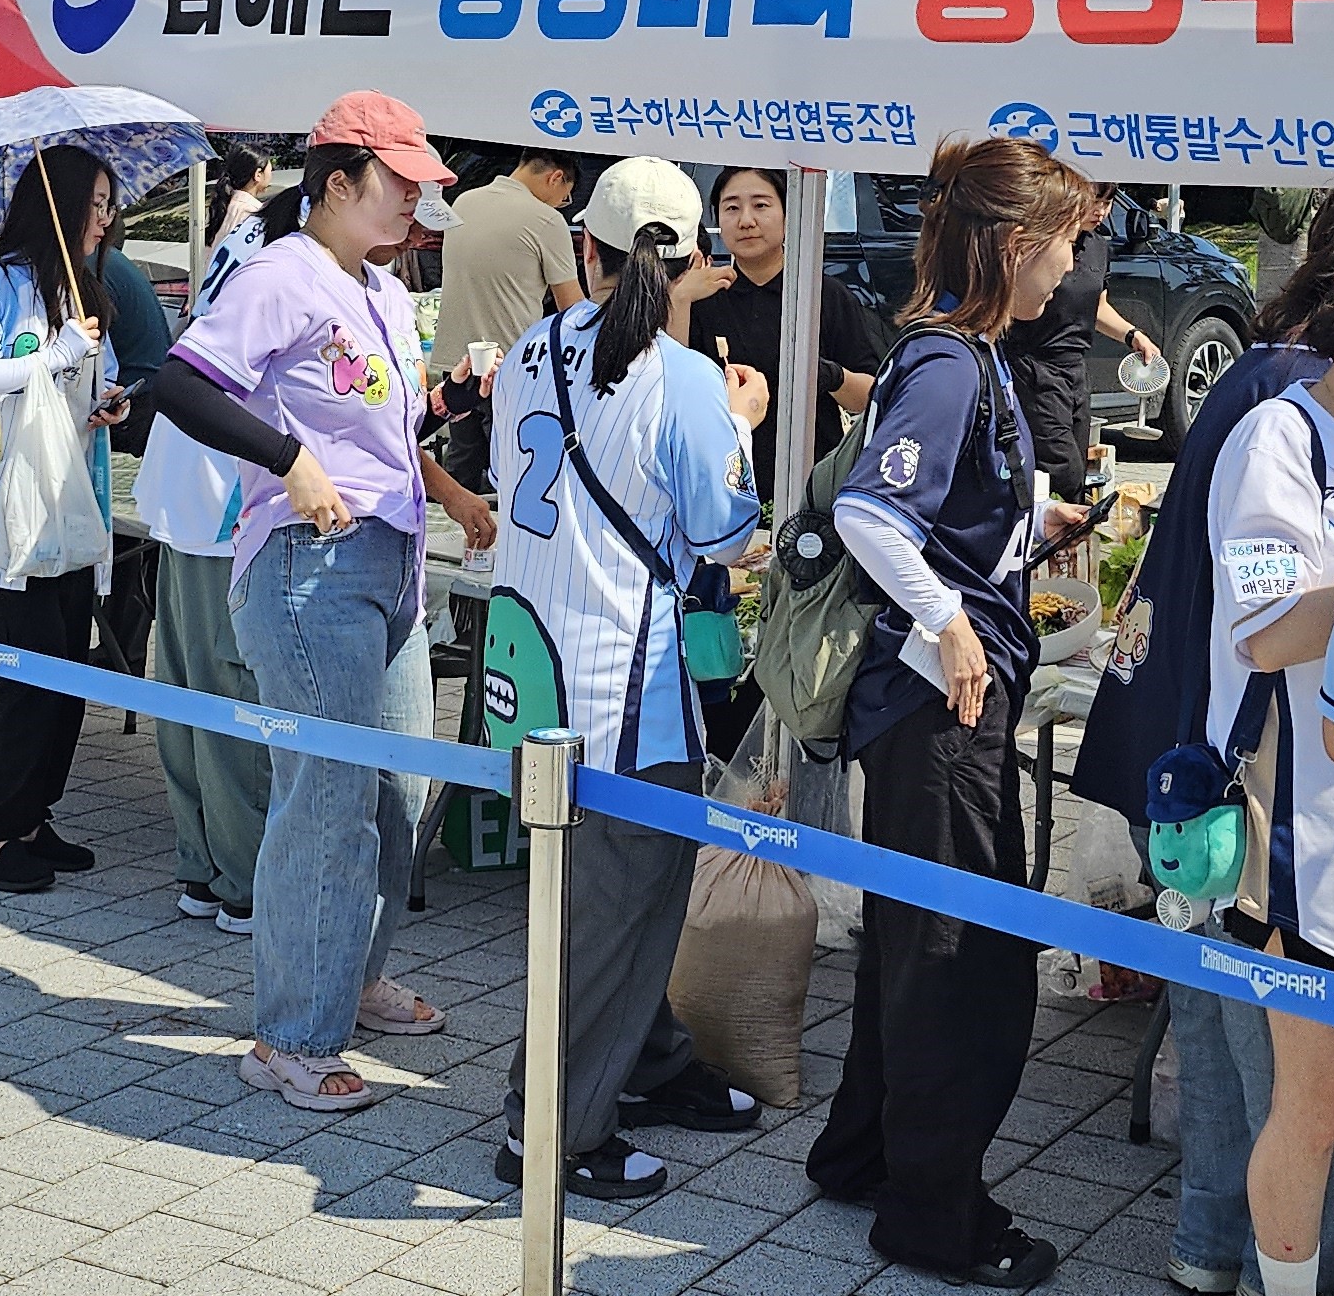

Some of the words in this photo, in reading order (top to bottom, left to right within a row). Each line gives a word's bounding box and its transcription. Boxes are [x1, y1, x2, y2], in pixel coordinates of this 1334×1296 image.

[589, 95, 917, 147] 굴수하식수산업협동조합
[510, 410, 565, 541] 2
[1238, 555, 1298, 580] 365일
[272, 716, 299, 735] PARK
[761, 824, 798, 849] PARK
[1275, 971, 1326, 1001] PARK
